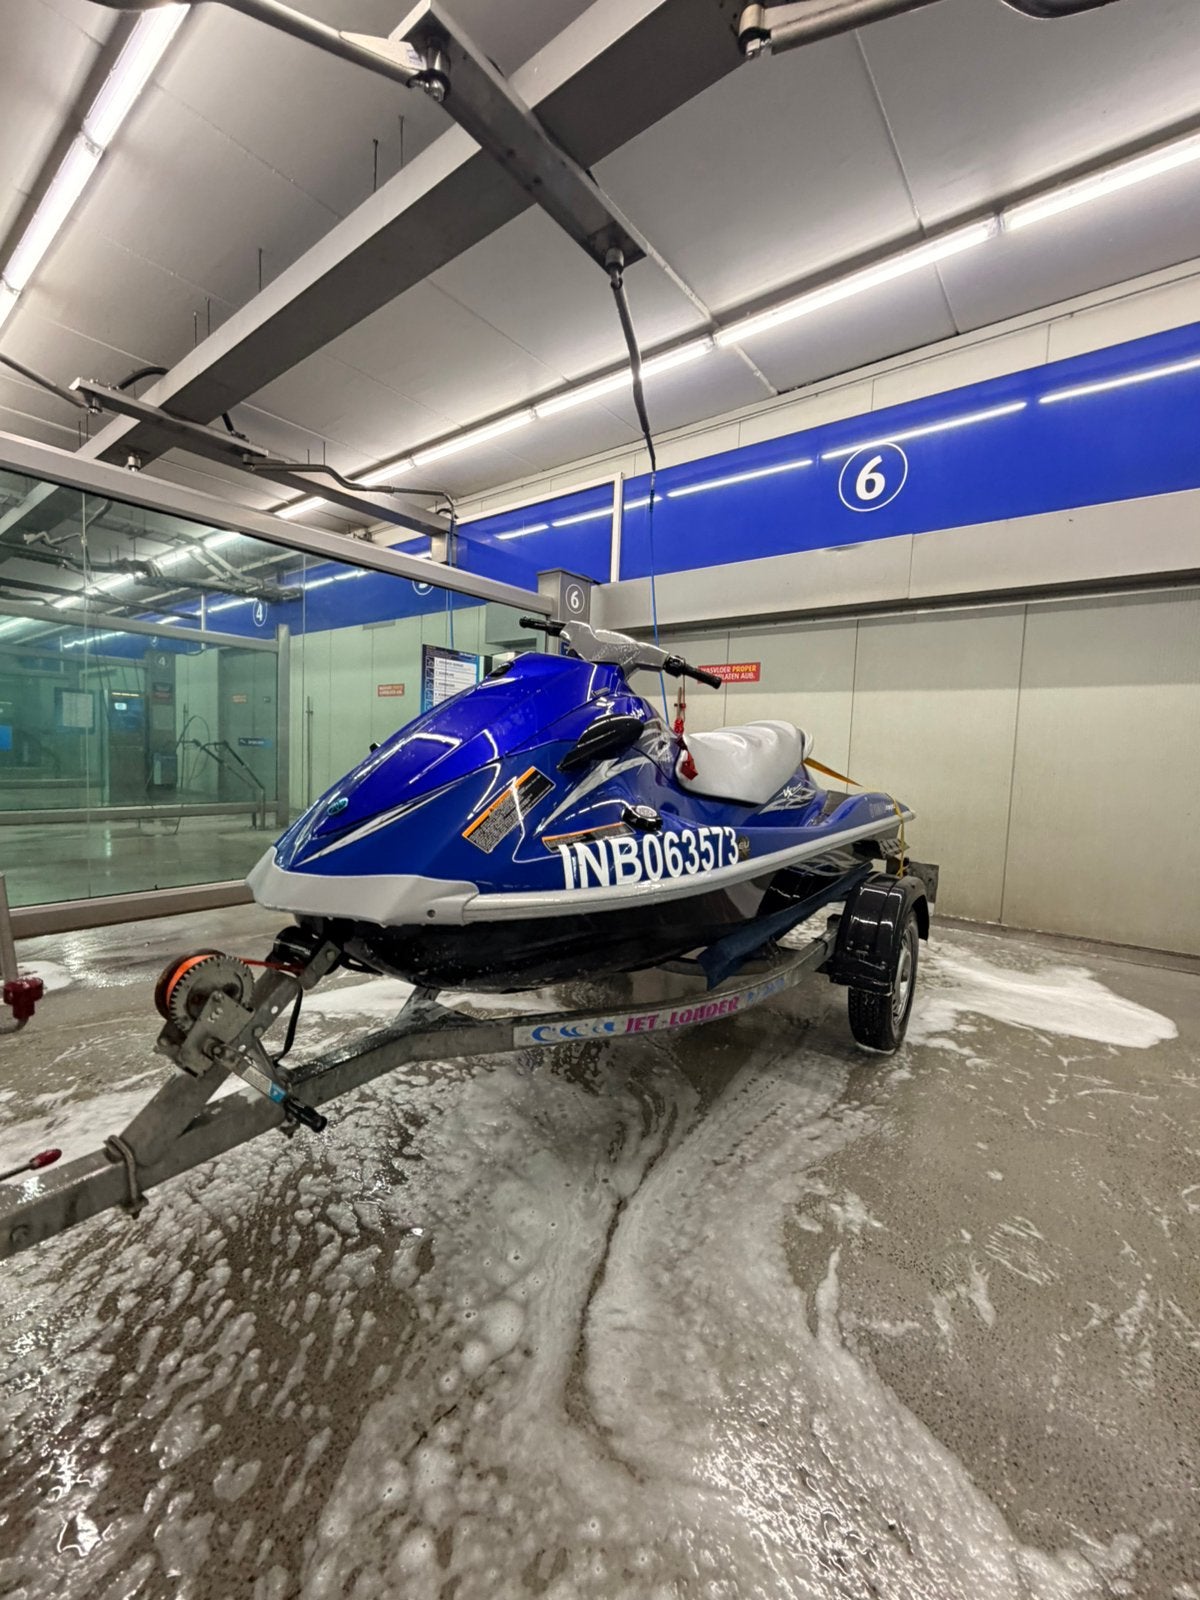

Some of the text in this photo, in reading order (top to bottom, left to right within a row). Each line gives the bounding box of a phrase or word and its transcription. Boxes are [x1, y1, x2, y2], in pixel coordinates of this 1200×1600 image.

[855, 454, 886, 501] 6
[570, 590, 580, 609] 6
[256, 603, 264, 622] 4
